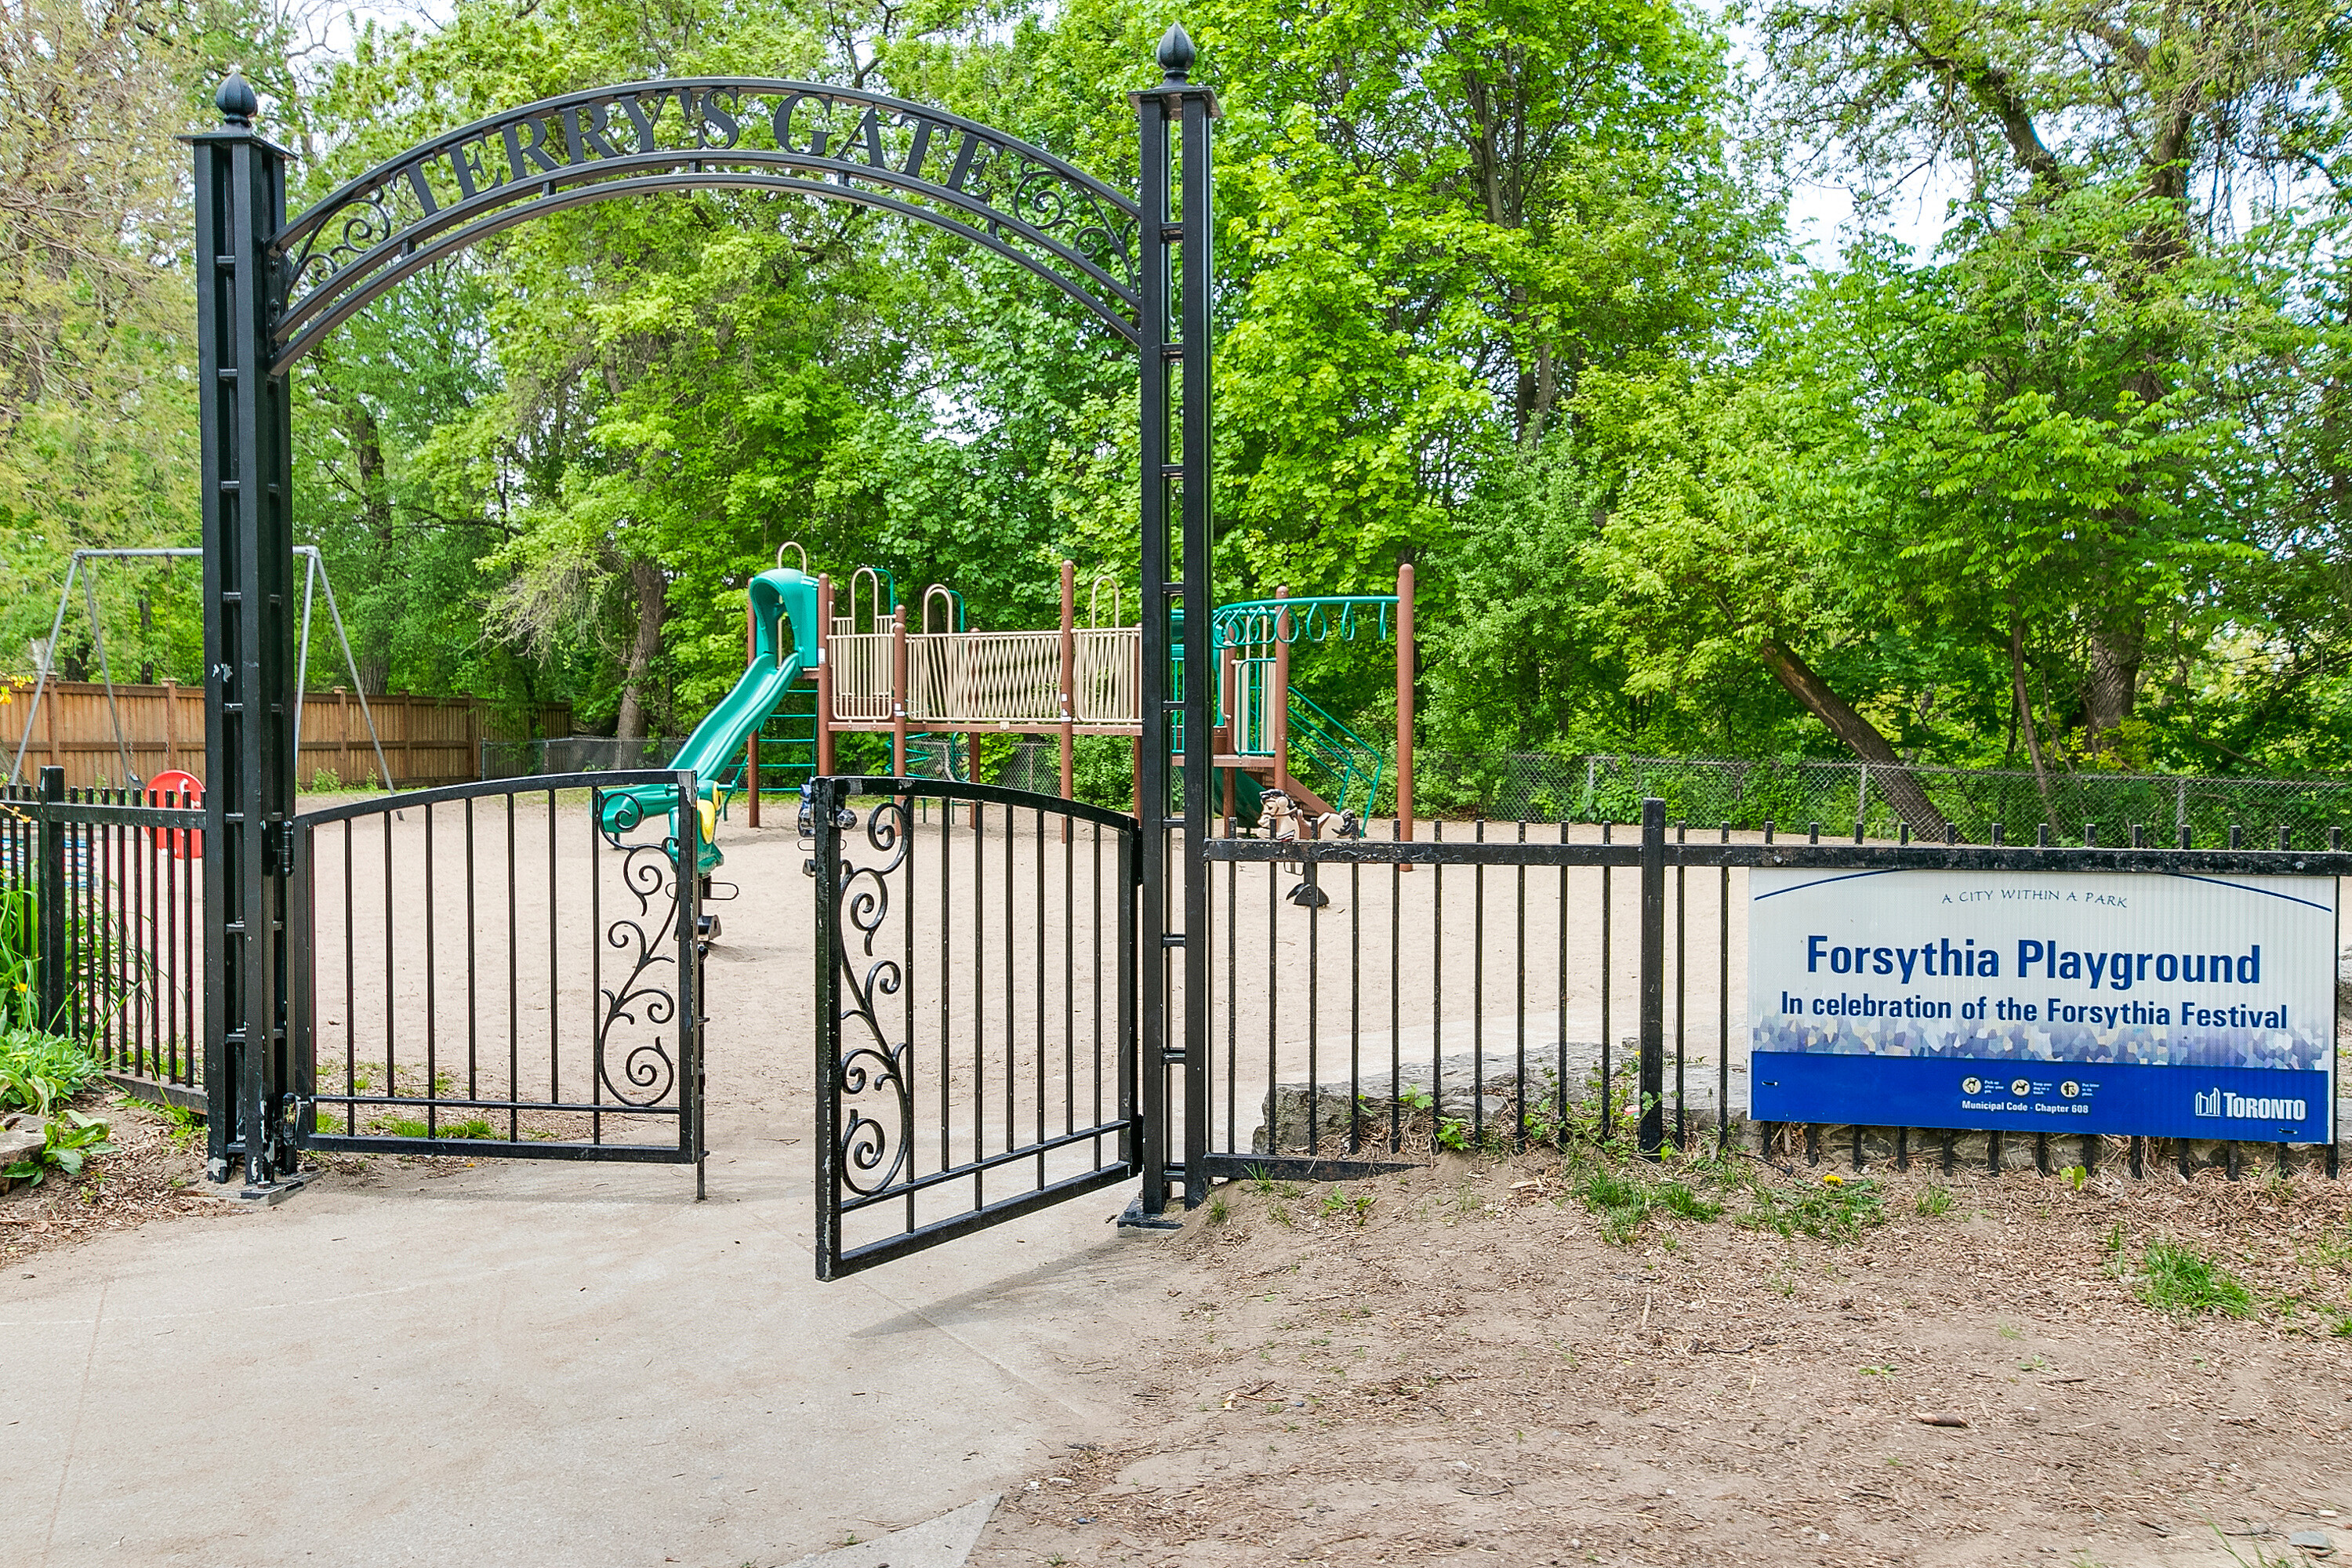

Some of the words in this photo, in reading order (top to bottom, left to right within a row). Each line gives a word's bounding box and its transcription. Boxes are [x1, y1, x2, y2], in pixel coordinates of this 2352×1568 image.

[390, 85, 739, 217] TERRY'S
[773, 90, 1006, 201] GATE
[1942, 893, 1953, 904] A
[1958, 890, 1994, 902] CITY
[2001, 889, 2060, 901] WITHIN
[2067, 891, 2078, 902] A
[2085, 892, 2128, 909] PARK
[1807, 935, 1999, 985] Forsythia
[2017, 939, 2261, 991] Playground
[1781, 991, 1803, 1014] In
[1812, 993, 1952, 1018] celebration
[1962, 996, 1987, 1020] of
[1995, 996, 2038, 1022] the
[2047, 998, 2171, 1029] Forsythia
[2182, 1001, 2288, 1029] Festival
[1962, 1100, 2005, 1112] Municipal
[2006, 1102, 2028, 1112] Code
[2035, 1103, 2070, 1113] Chapter
[2071, 1105, 2089, 1114] 608
[2223, 1092, 2307, 1121] TORONTO
